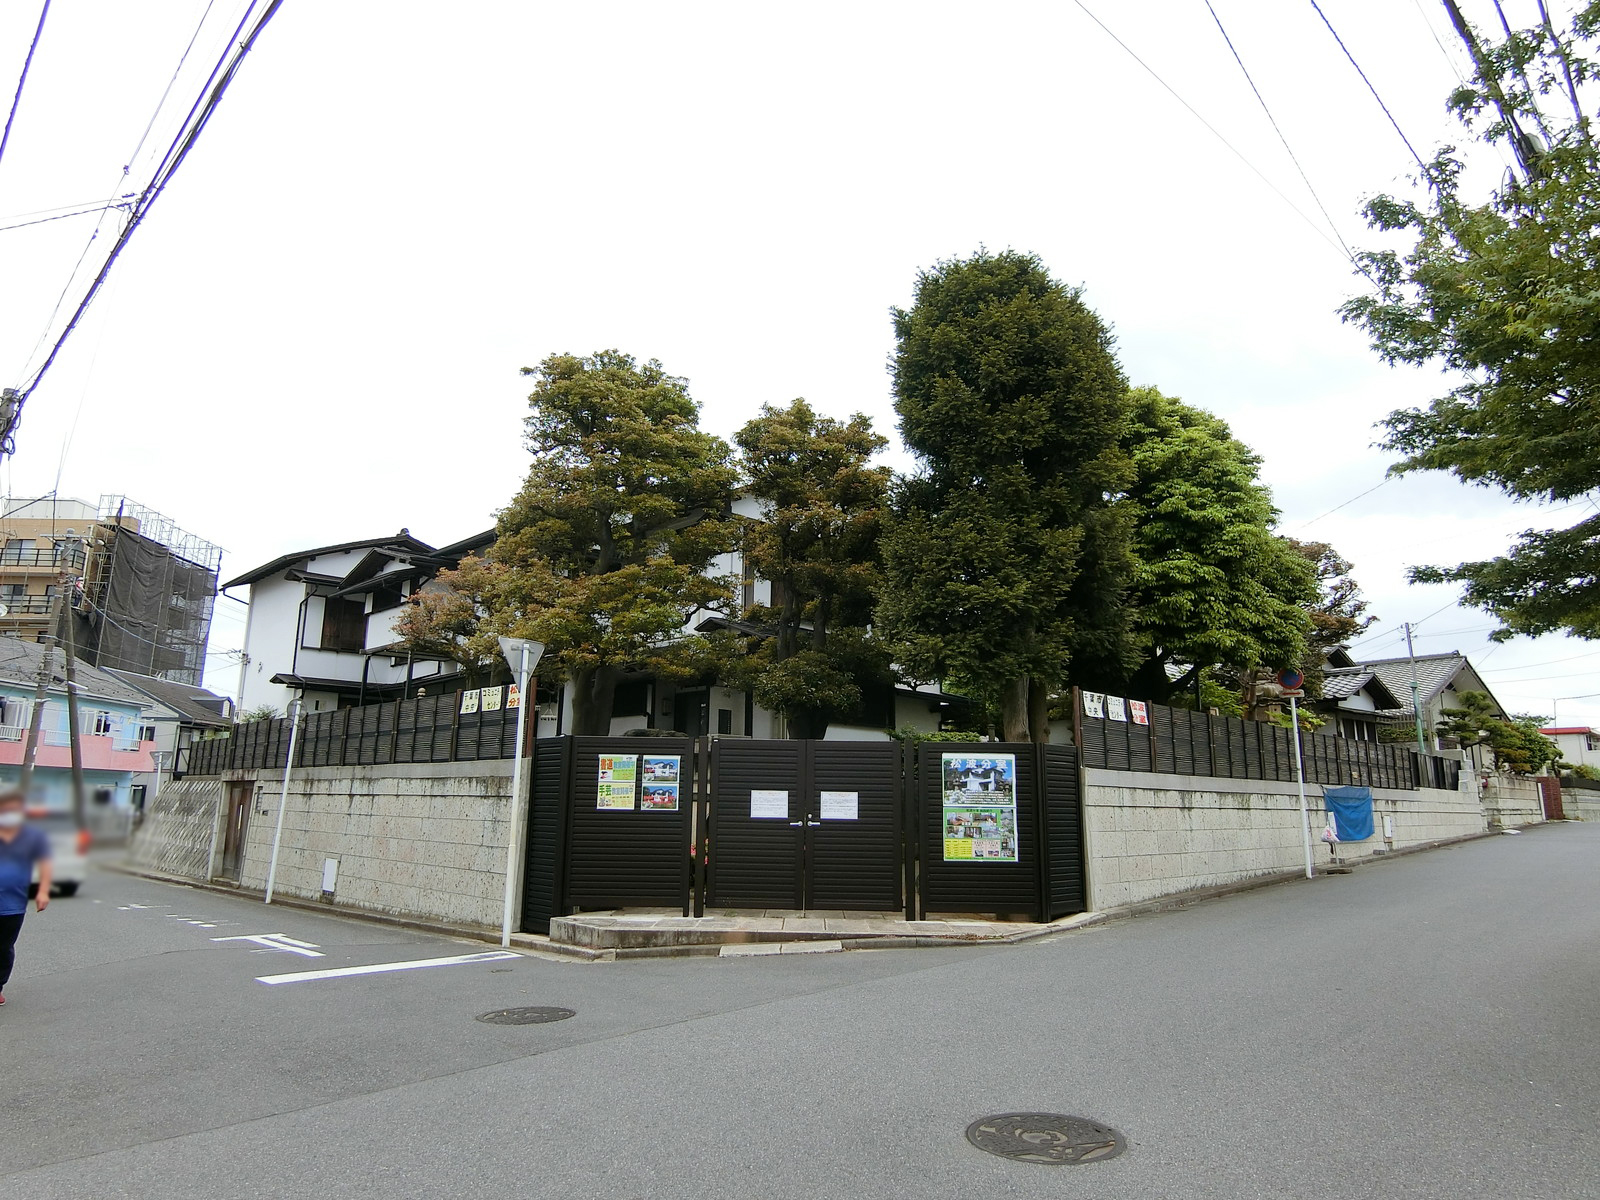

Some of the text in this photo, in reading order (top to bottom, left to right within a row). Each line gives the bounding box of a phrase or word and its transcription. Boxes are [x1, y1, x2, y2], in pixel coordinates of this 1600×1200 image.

[601, 758, 613, 770] 書道
[950, 758, 1008, 769] 松波分室
[599, 784, 611, 796] 手芸
